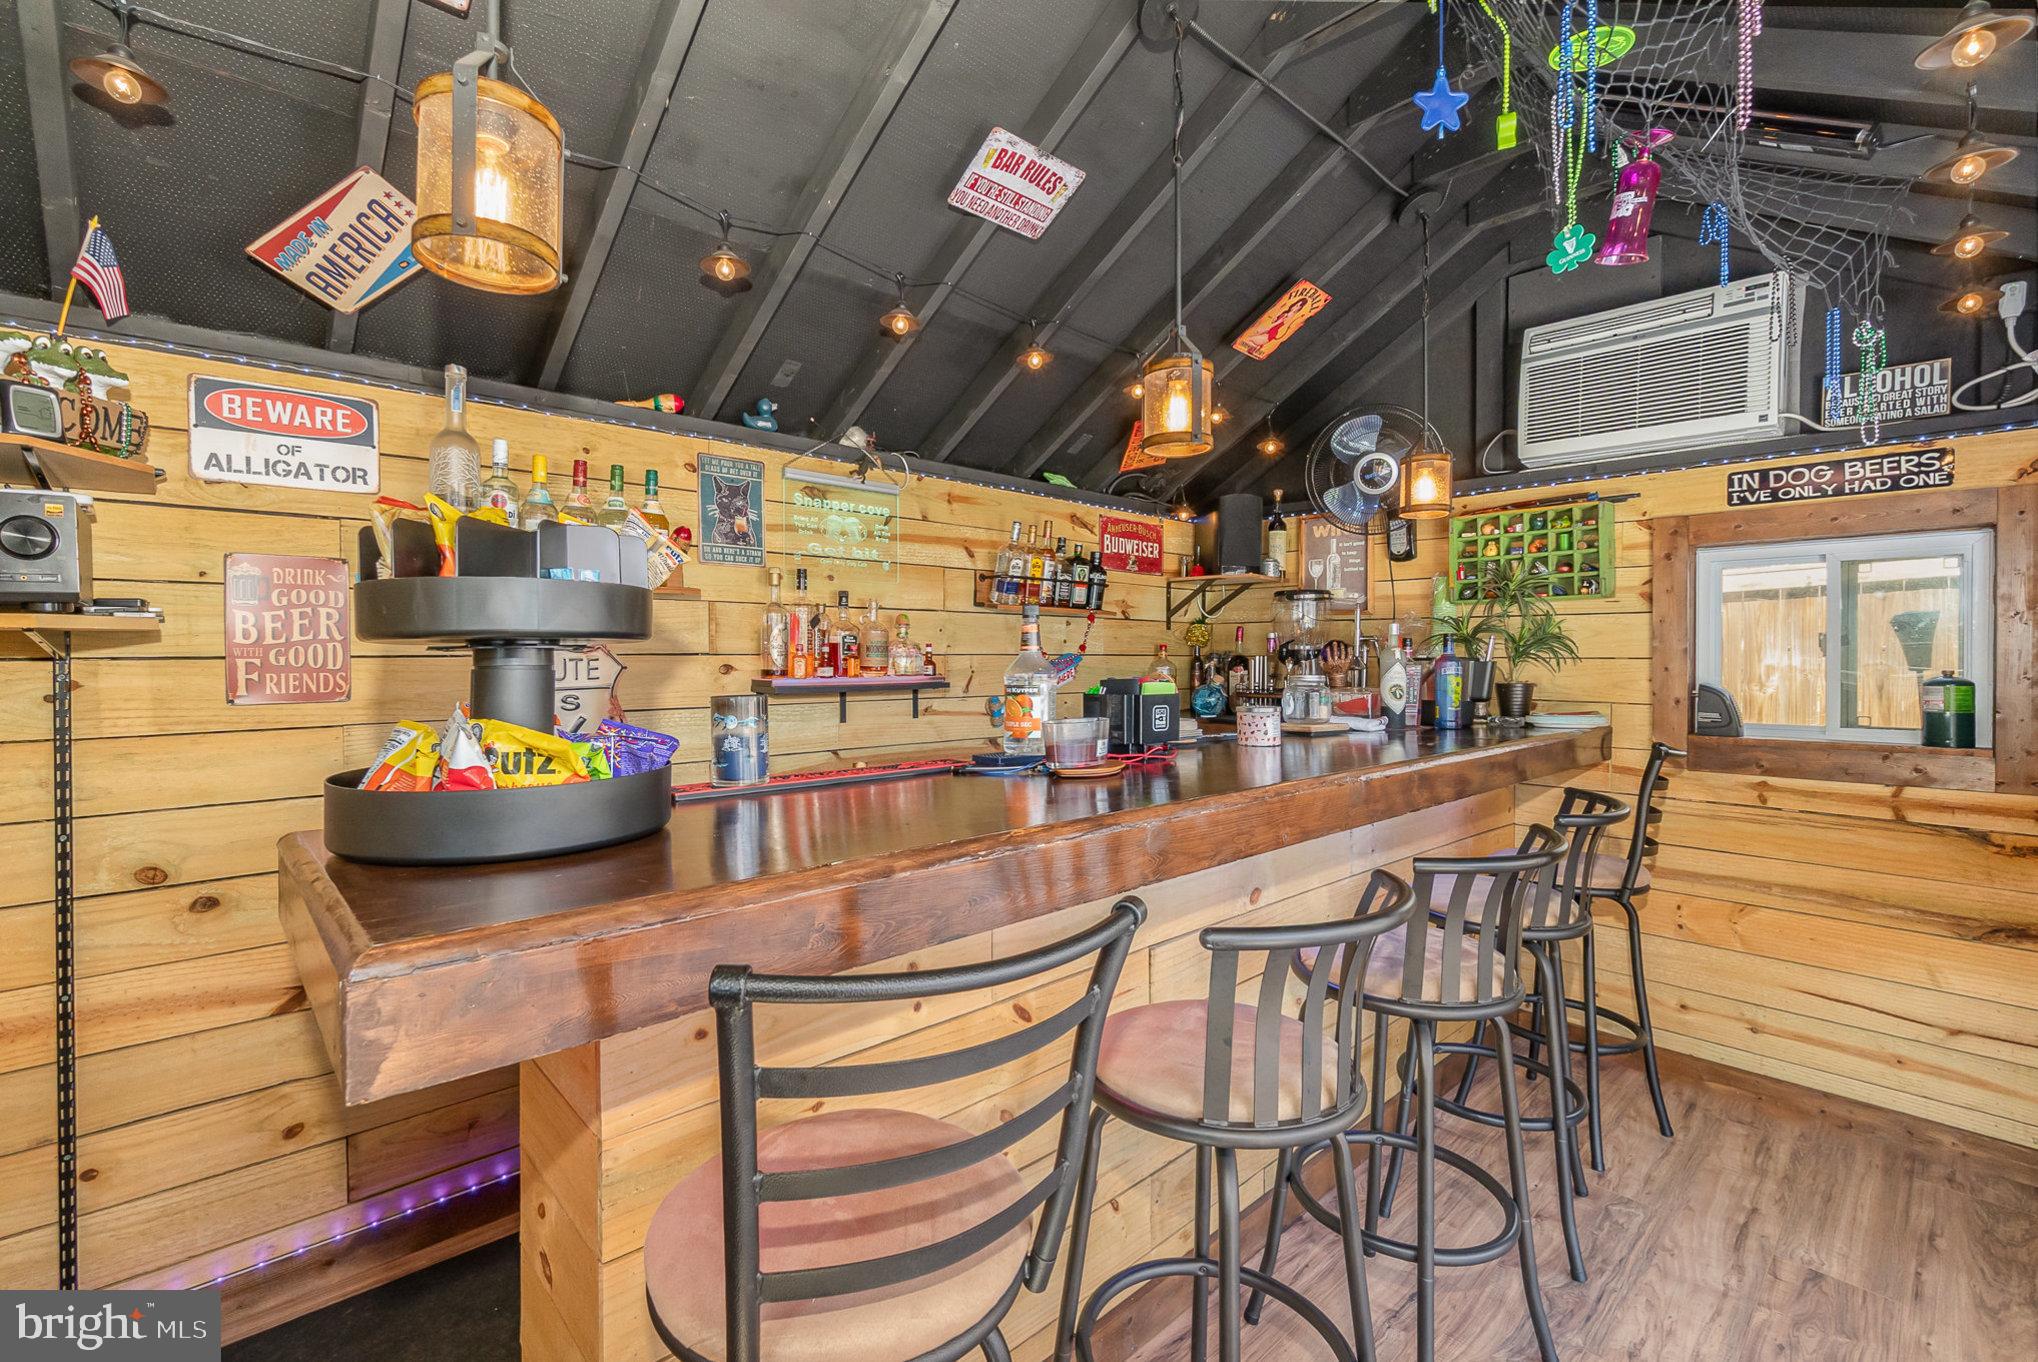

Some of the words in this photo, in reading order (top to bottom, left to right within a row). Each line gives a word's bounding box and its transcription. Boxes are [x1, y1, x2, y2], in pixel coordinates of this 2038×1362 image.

[992, 148, 1026, 176] BAR
[1019, 159, 1063, 195] RULES
[950, 188, 970, 205] YOU
[966, 195, 989, 213] NEED
[985, 204, 1021, 228] ANOTHER
[274, 230, 318, 272] MADE
[307, 216, 333, 239] IN
[305, 199, 406, 301] AMERICA
[1825, 397, 1864, 410] BCAUS
[1883, 389, 1913, 402] GREAT
[1915, 385, 1948, 397] STORY
[1826, 362, 1948, 401] LOHOL
[221, 393, 351, 433] BEWARE
[1825, 408, 1853, 418] EER
[1916, 394, 1947, 406] WITH
[1825, 415, 1864, 428] SOMEO
[1871, 410, 1903, 422] ATING
[1905, 409, 1912, 418] A
[1914, 404, 1947, 416] SALAD
[60, 397, 142, 449] COME
[277, 444, 302, 457] OF
[204, 453, 369, 485] ALLIGATOR
[1728, 473, 1760, 492] IN
[1769, 466, 1834, 488] DOG
[1731, 489, 1772, 504] I'VE
[1778, 484, 1838, 500] ONLY
[1845, 478, 1891, 493] HAD
[1900, 471, 1950, 488] ONE
[1104, 534, 1160, 559] BUDWEISER
[272, 567, 326, 586] DRINK
[271, 588, 344, 608] GOOD
[232, 607, 344, 645] BEER
[233, 647, 263, 657] WITH
[269, 642, 344, 670] GOOD
[555, 657, 600, 681] UTE
[234, 658, 346, 696] FRIENDS
